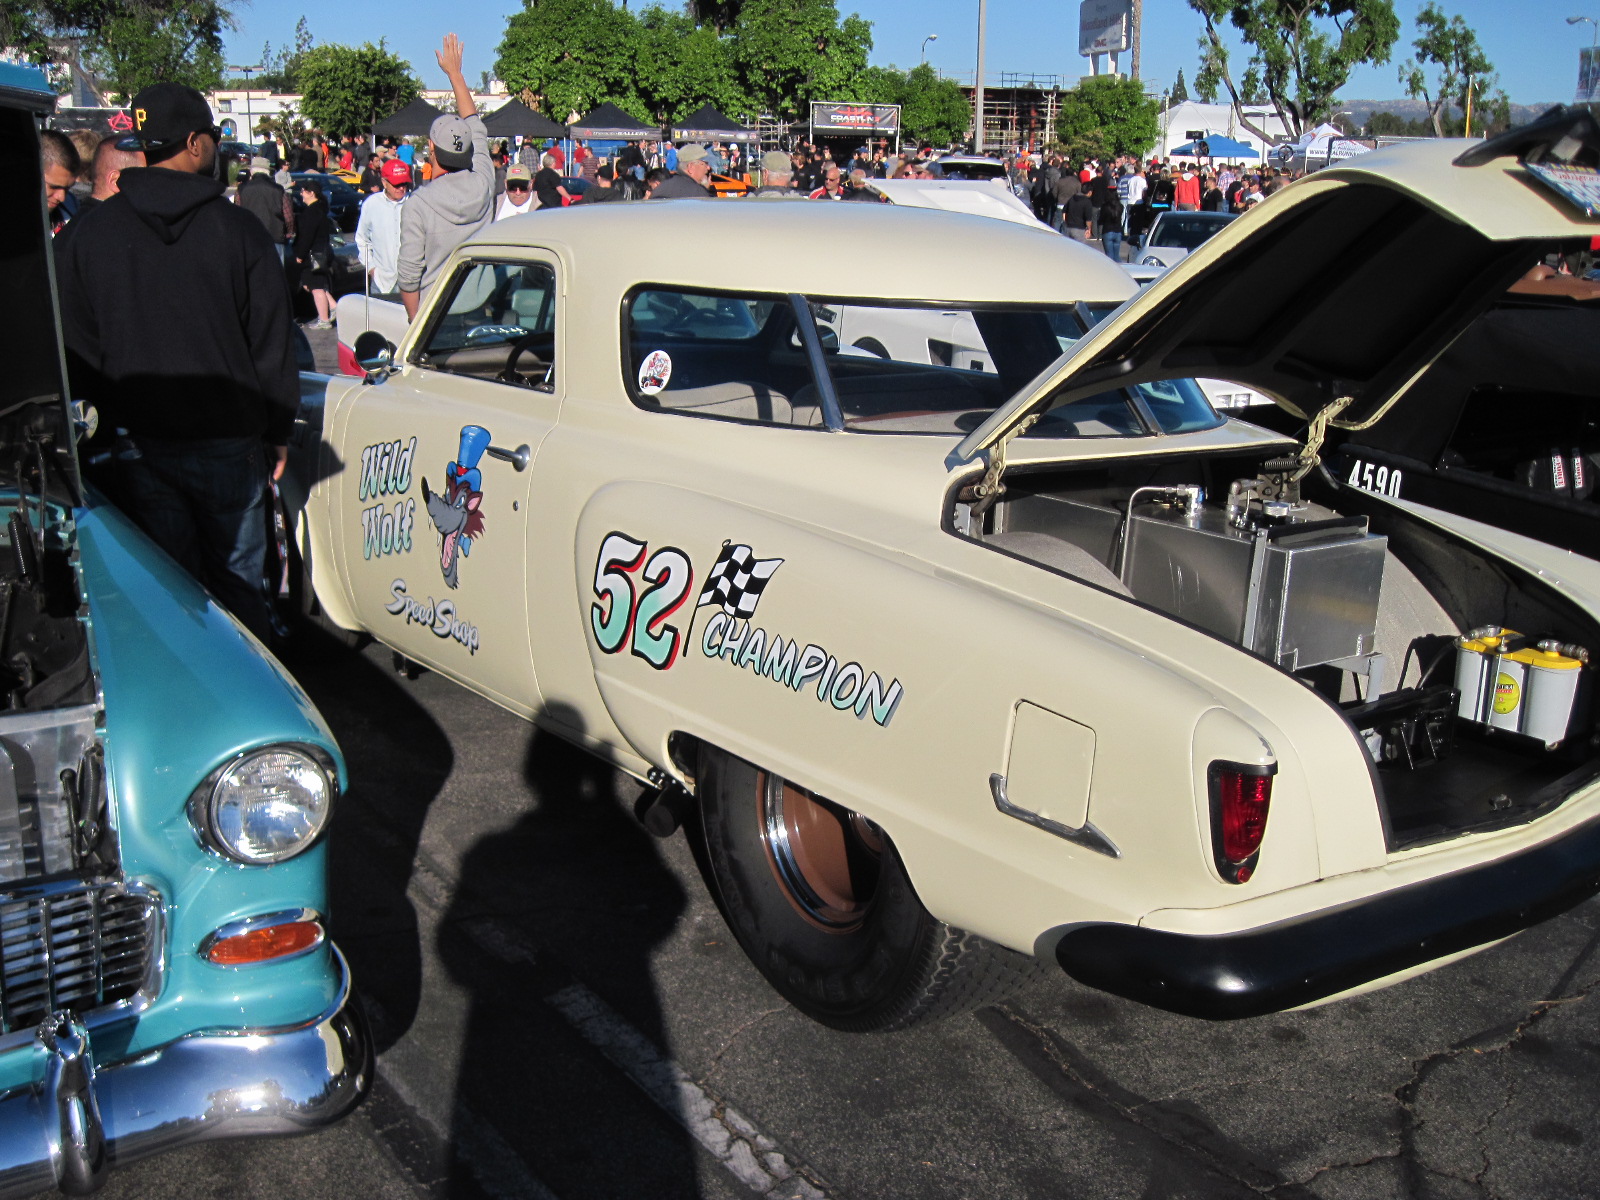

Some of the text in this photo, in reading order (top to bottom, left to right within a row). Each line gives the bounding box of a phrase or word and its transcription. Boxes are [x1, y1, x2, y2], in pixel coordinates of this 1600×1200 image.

[136, 108, 147, 130] P
[359, 436, 417, 502] Wild
[1348, 460, 1402, 499] 4590
[361, 498, 415, 561] Wolf
[591, 530, 693, 670] 52
[702, 611, 904, 727] CHAMPION
